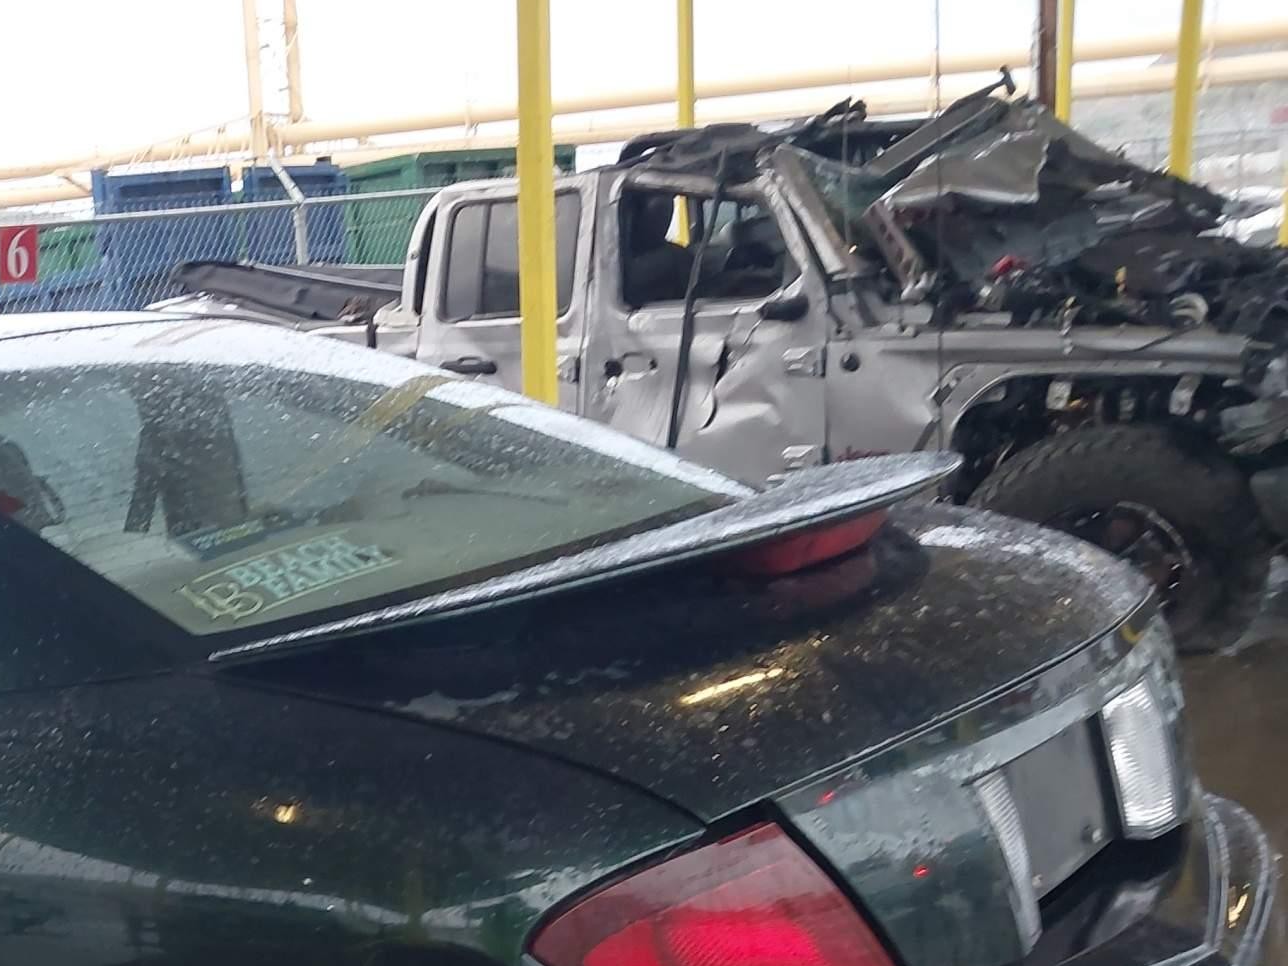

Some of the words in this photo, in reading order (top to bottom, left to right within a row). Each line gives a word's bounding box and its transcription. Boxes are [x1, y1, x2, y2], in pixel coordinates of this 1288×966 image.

[7, 226, 30, 279] 6
[226, 536, 354, 589] BEACH
[264, 545, 390, 599] FAMILY
